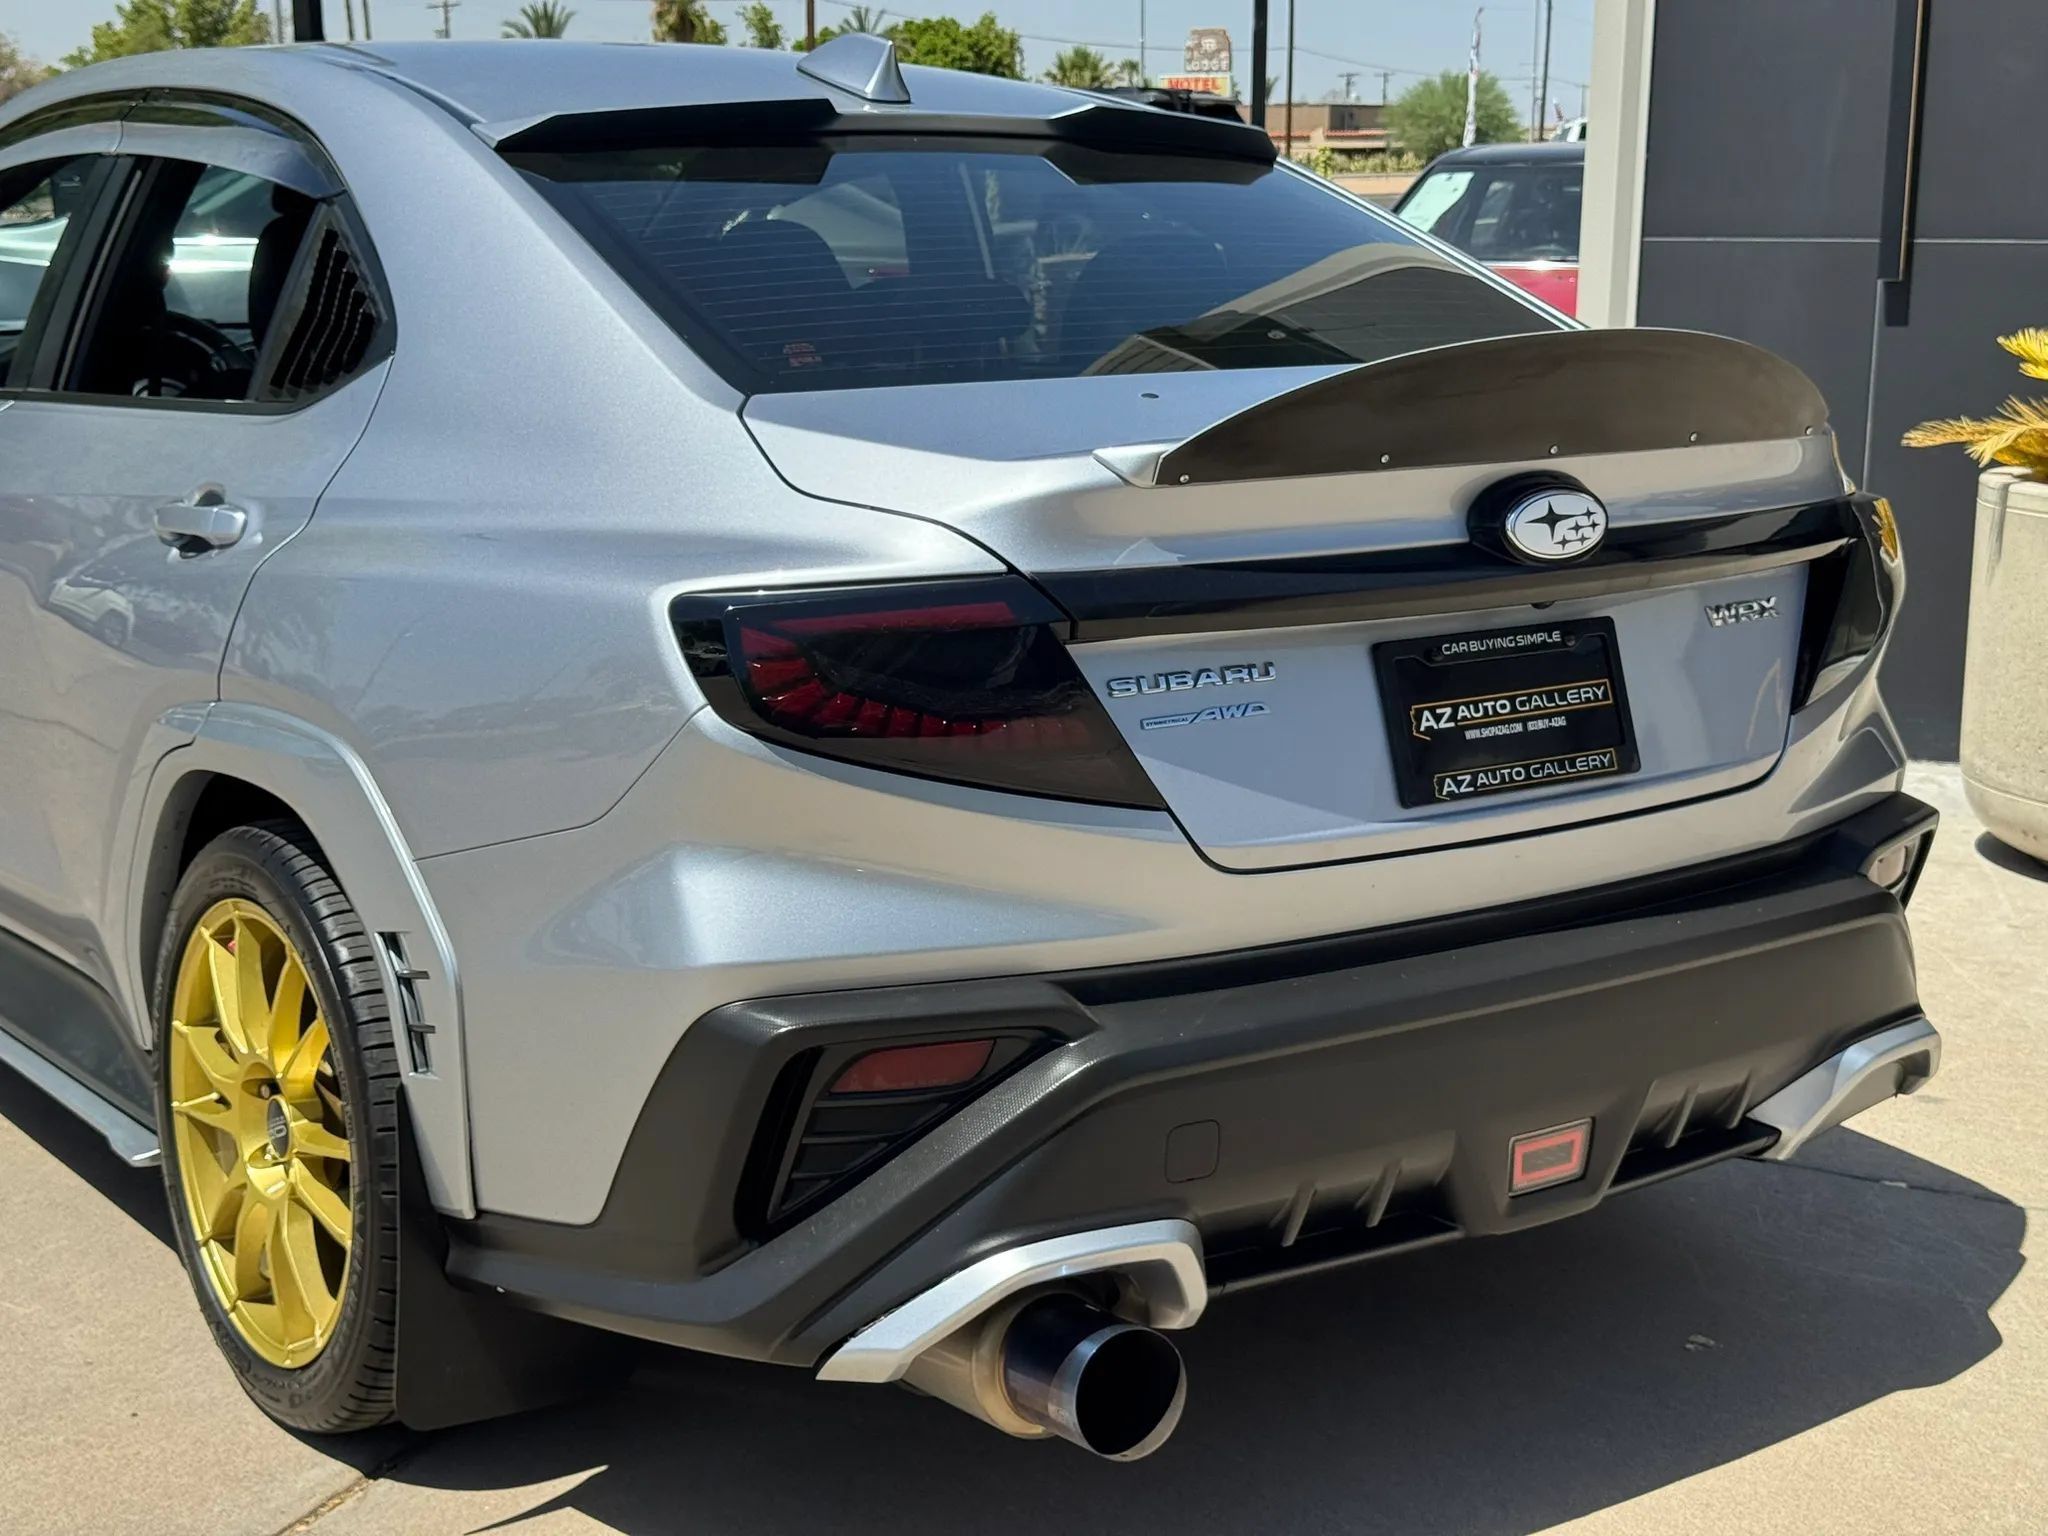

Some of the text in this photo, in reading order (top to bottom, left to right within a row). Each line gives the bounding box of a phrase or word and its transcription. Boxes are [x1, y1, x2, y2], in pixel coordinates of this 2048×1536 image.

[1704, 596, 1779, 628] WRX
[1441, 630, 1562, 656] CAR BUYING SIMPLE
[1107, 661, 1277, 698] SUBARU
[1191, 702, 1272, 722] AWD
[1419, 685, 1606, 732] AZ AUTO GALLERY
[1464, 722, 1524, 740] WWW.SHOPAZAG.COM
[1442, 753, 1612, 796] AZ AUTO GALLERY
